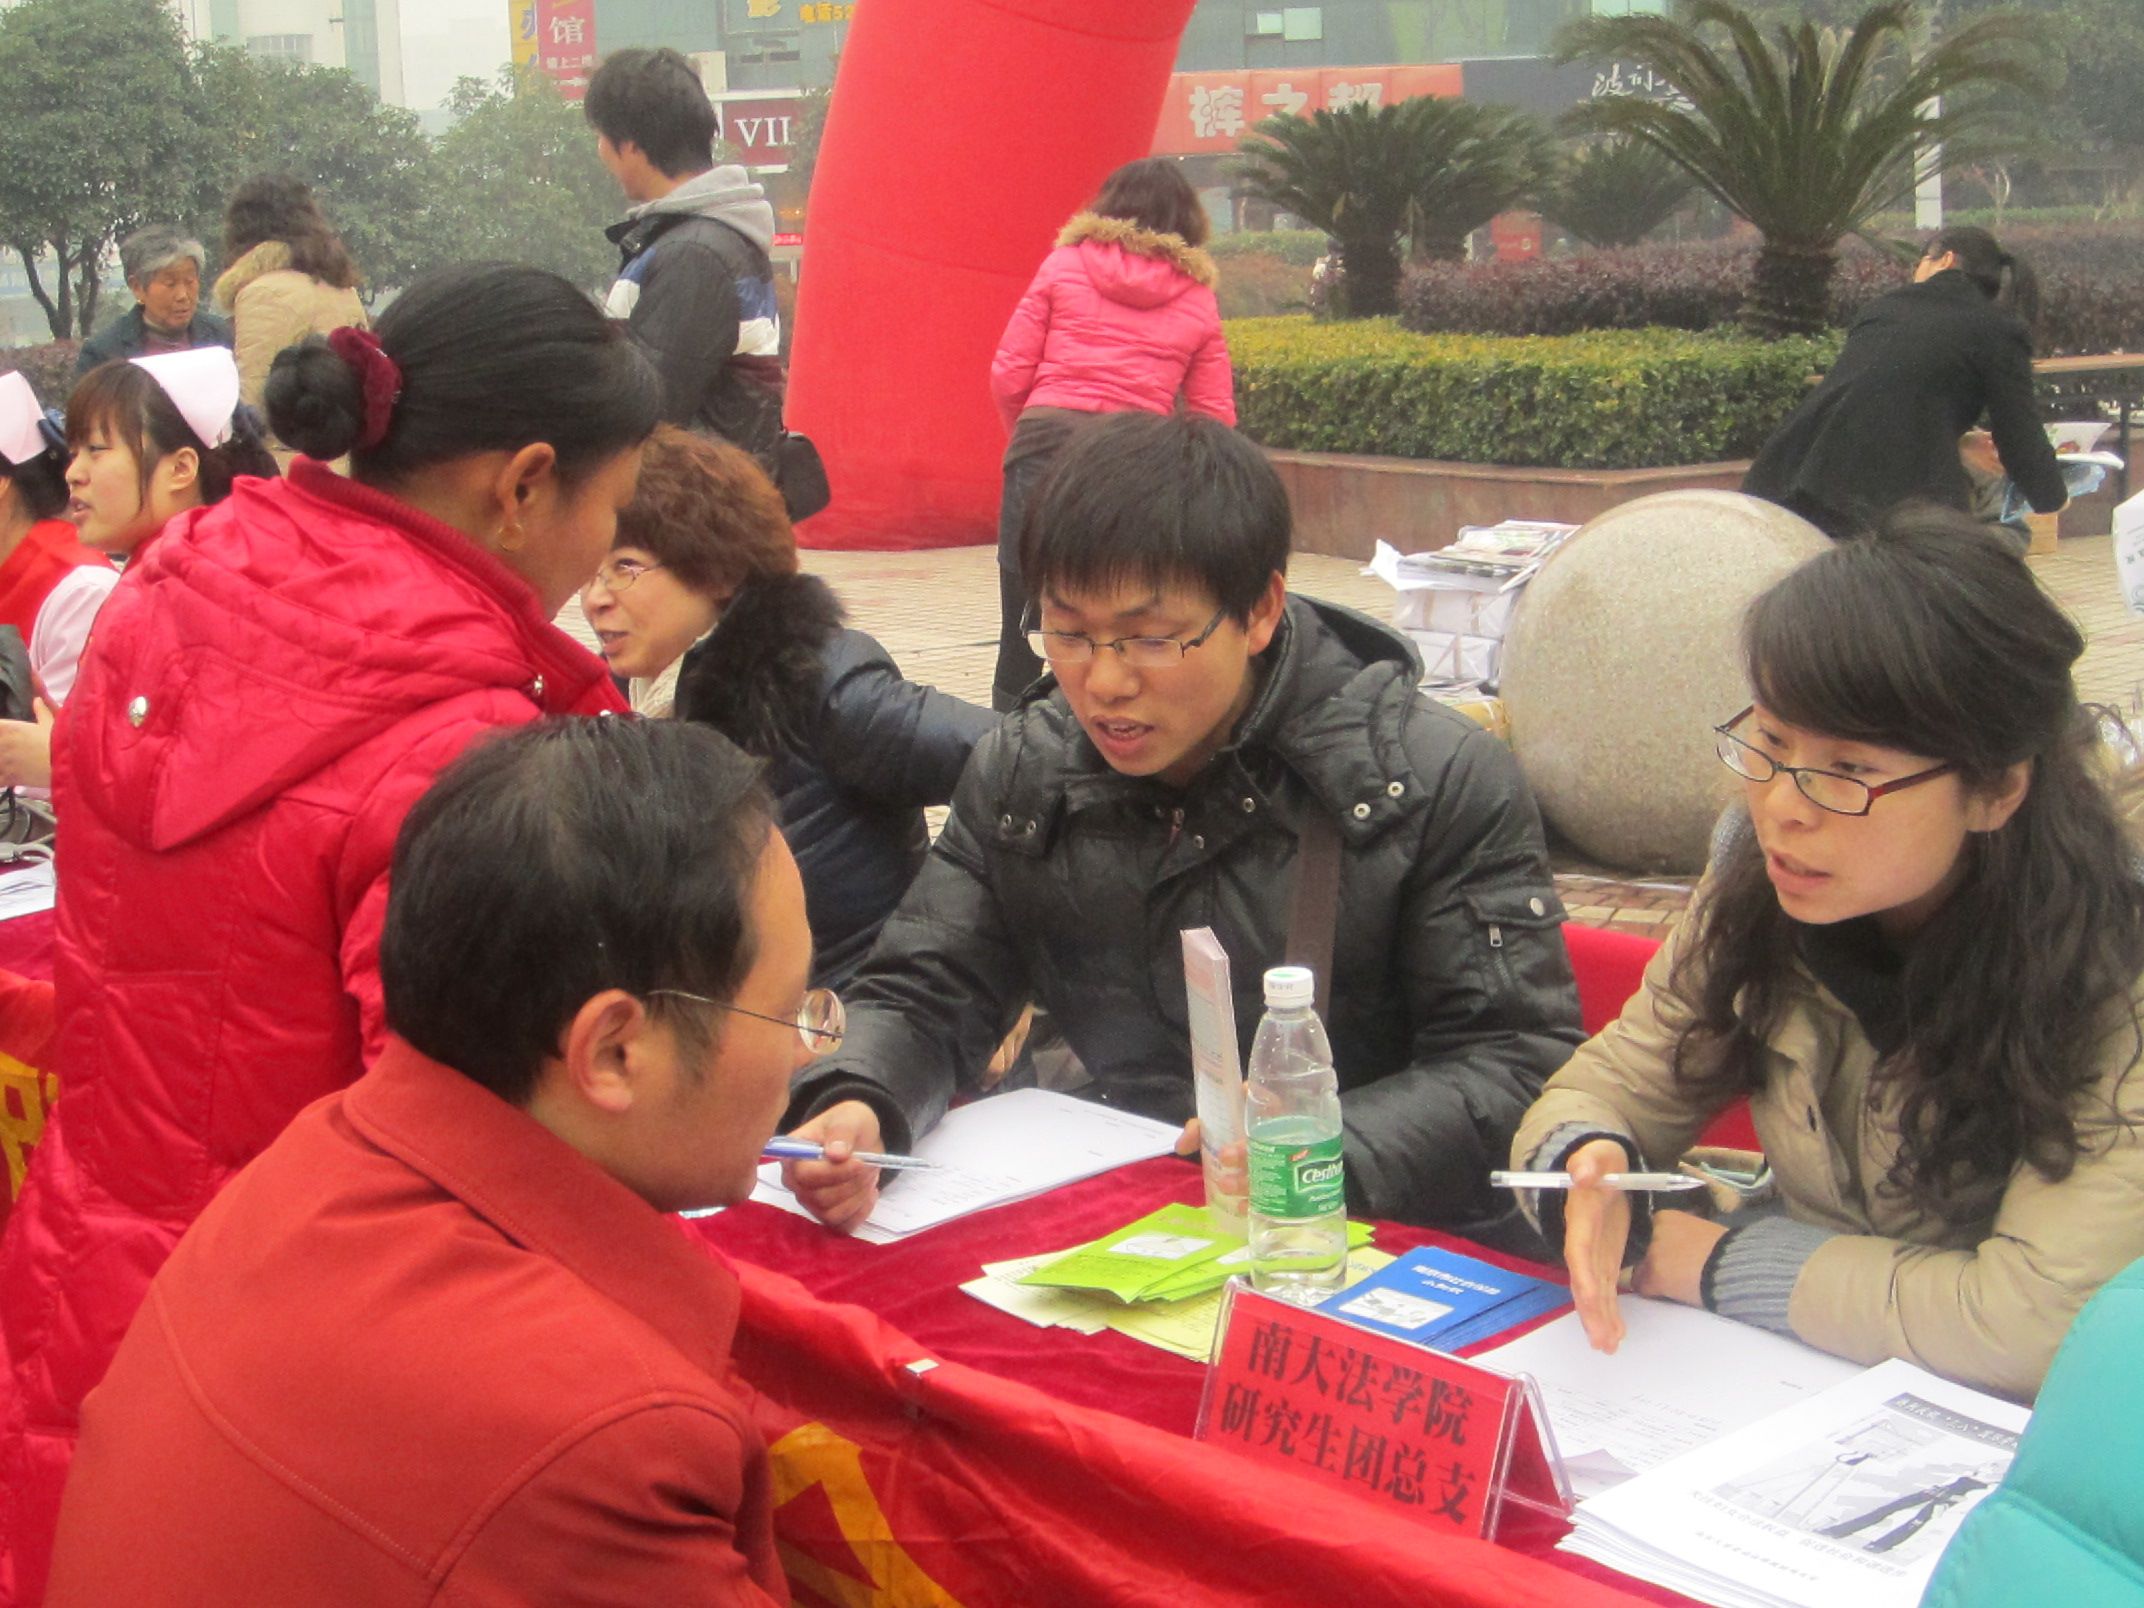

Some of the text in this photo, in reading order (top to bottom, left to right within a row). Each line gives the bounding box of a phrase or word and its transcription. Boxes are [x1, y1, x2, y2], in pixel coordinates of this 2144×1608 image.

[549, 16, 585, 45] 馆
[1247, 1320, 1474, 1447] 南大法学院
[1219, 1380, 1477, 1525] 研究生团总支
